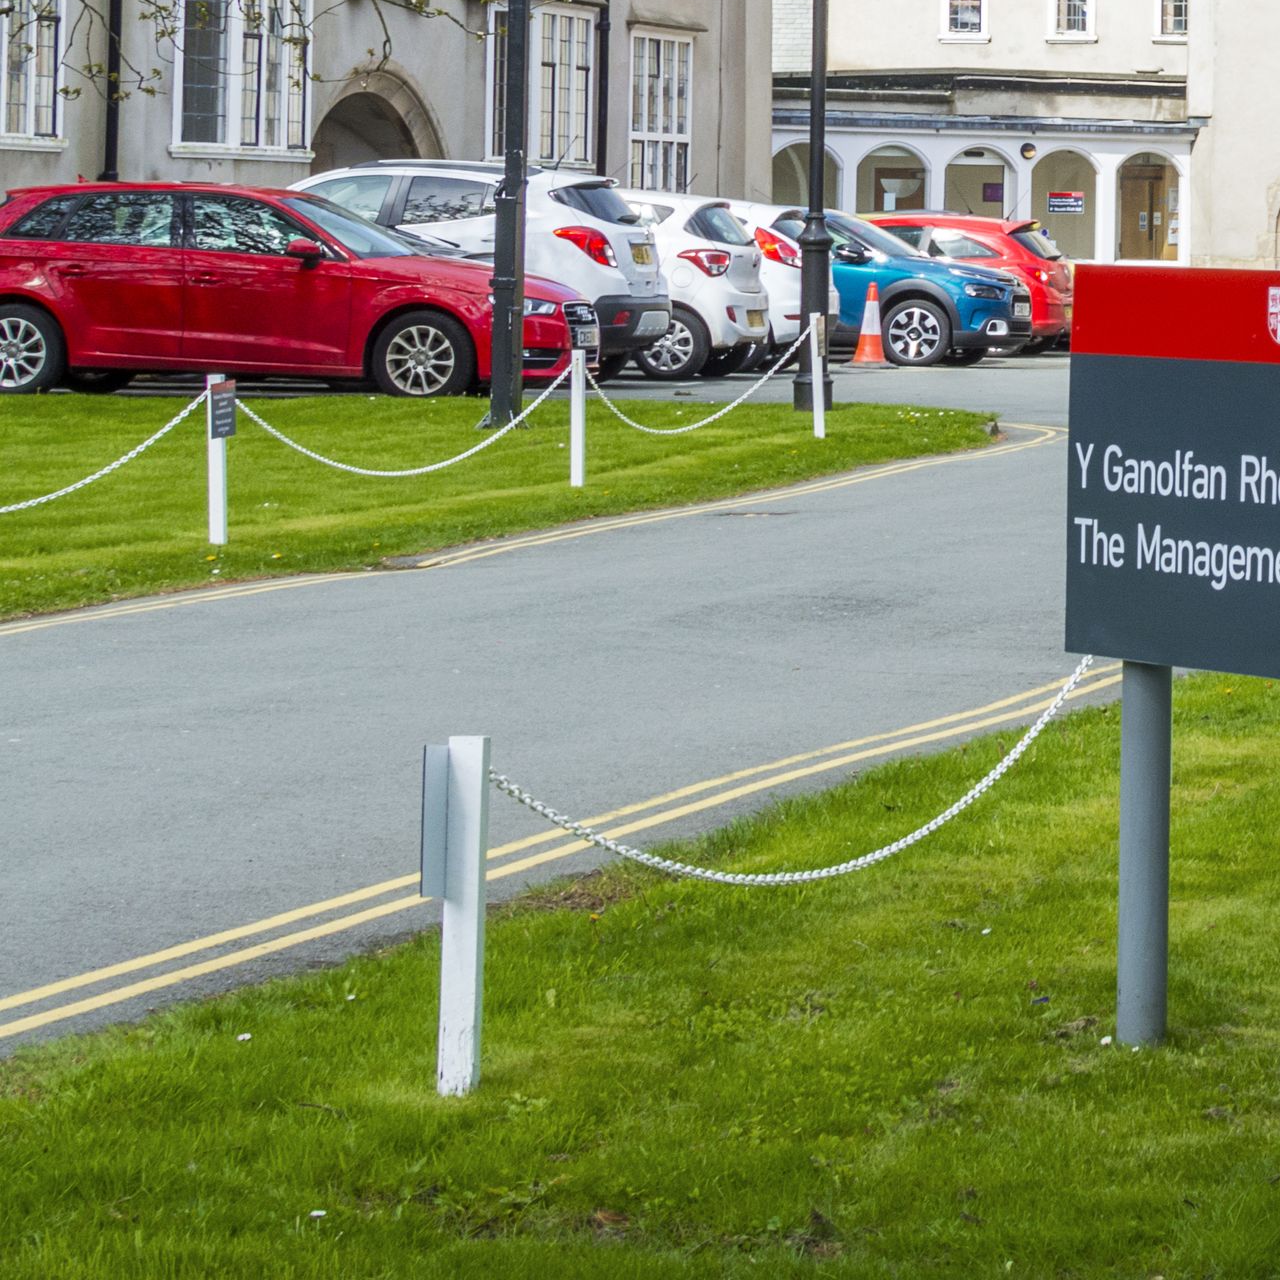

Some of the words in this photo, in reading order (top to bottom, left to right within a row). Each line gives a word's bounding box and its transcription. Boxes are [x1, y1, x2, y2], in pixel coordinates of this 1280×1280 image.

[1075, 442, 1095, 489] Y
[1103, 444, 1227, 501] Ganolfan
[1073, 517, 1125, 568] The
